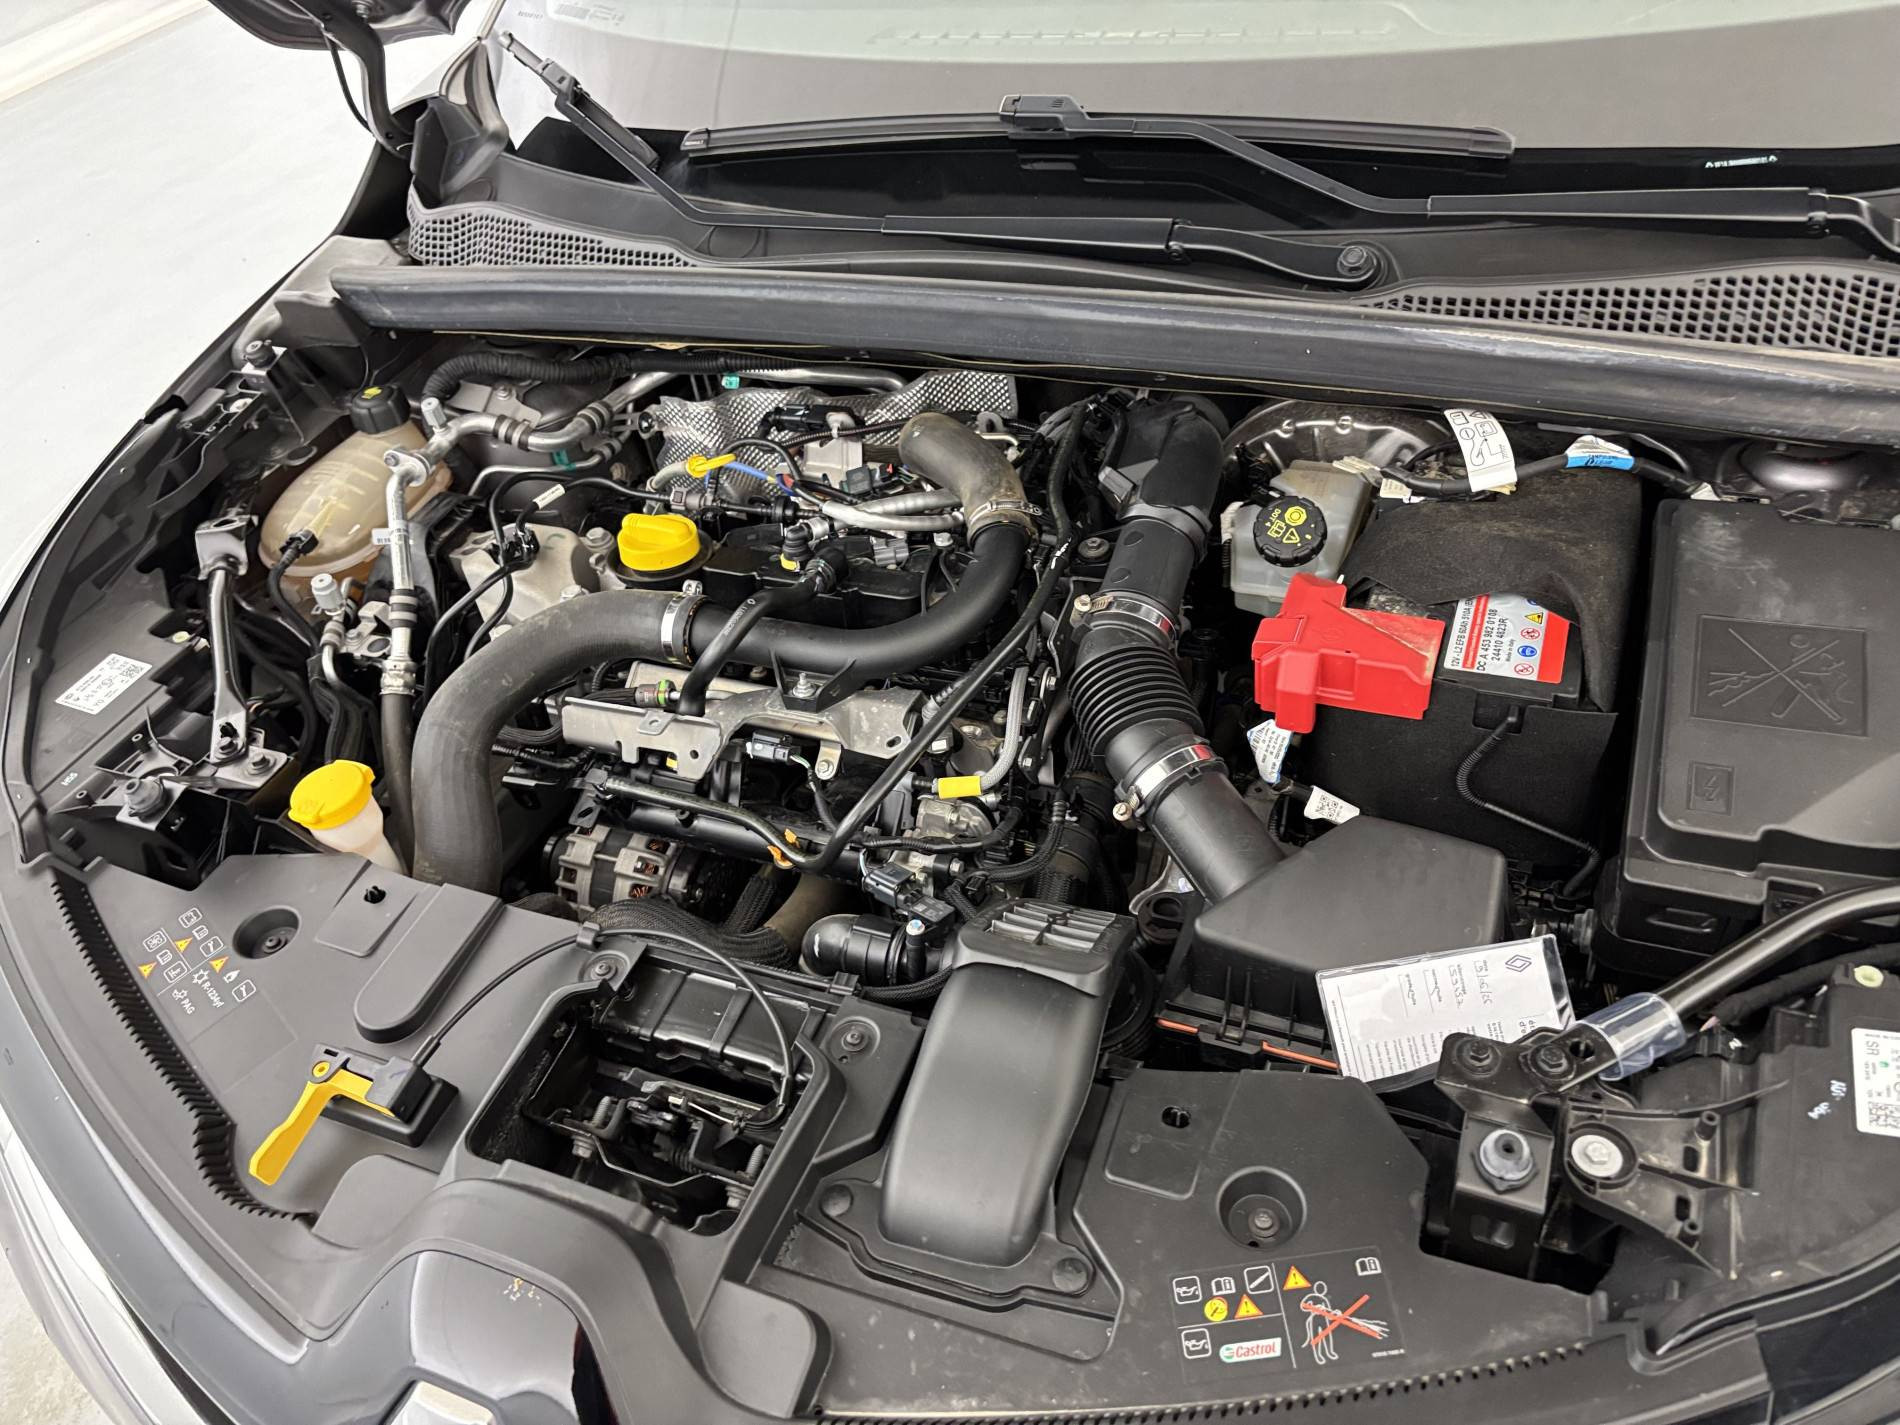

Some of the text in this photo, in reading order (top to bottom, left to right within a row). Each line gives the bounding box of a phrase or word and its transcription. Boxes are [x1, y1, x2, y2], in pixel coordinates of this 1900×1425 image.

[1269, 508, 1281, 522] DOT
[1462, 608, 1472, 620] 510A
[1486, 608, 1498, 625] 0108
[1458, 620, 1469, 634] 60Ah
[1484, 625, 1494, 638] 982
[1456, 634, 1465, 646] EFB
[1482, 638, 1491, 652] 453
[1454, 646, 1463, 654] L2
[1491, 640, 1504, 662] 24410
[1451, 656, 1460, 667] 12V
[1476, 660, 1486, 672] DC
[181, 998, 196, 1014] PAG
[1236, 1341, 1276, 1358] Castrol
